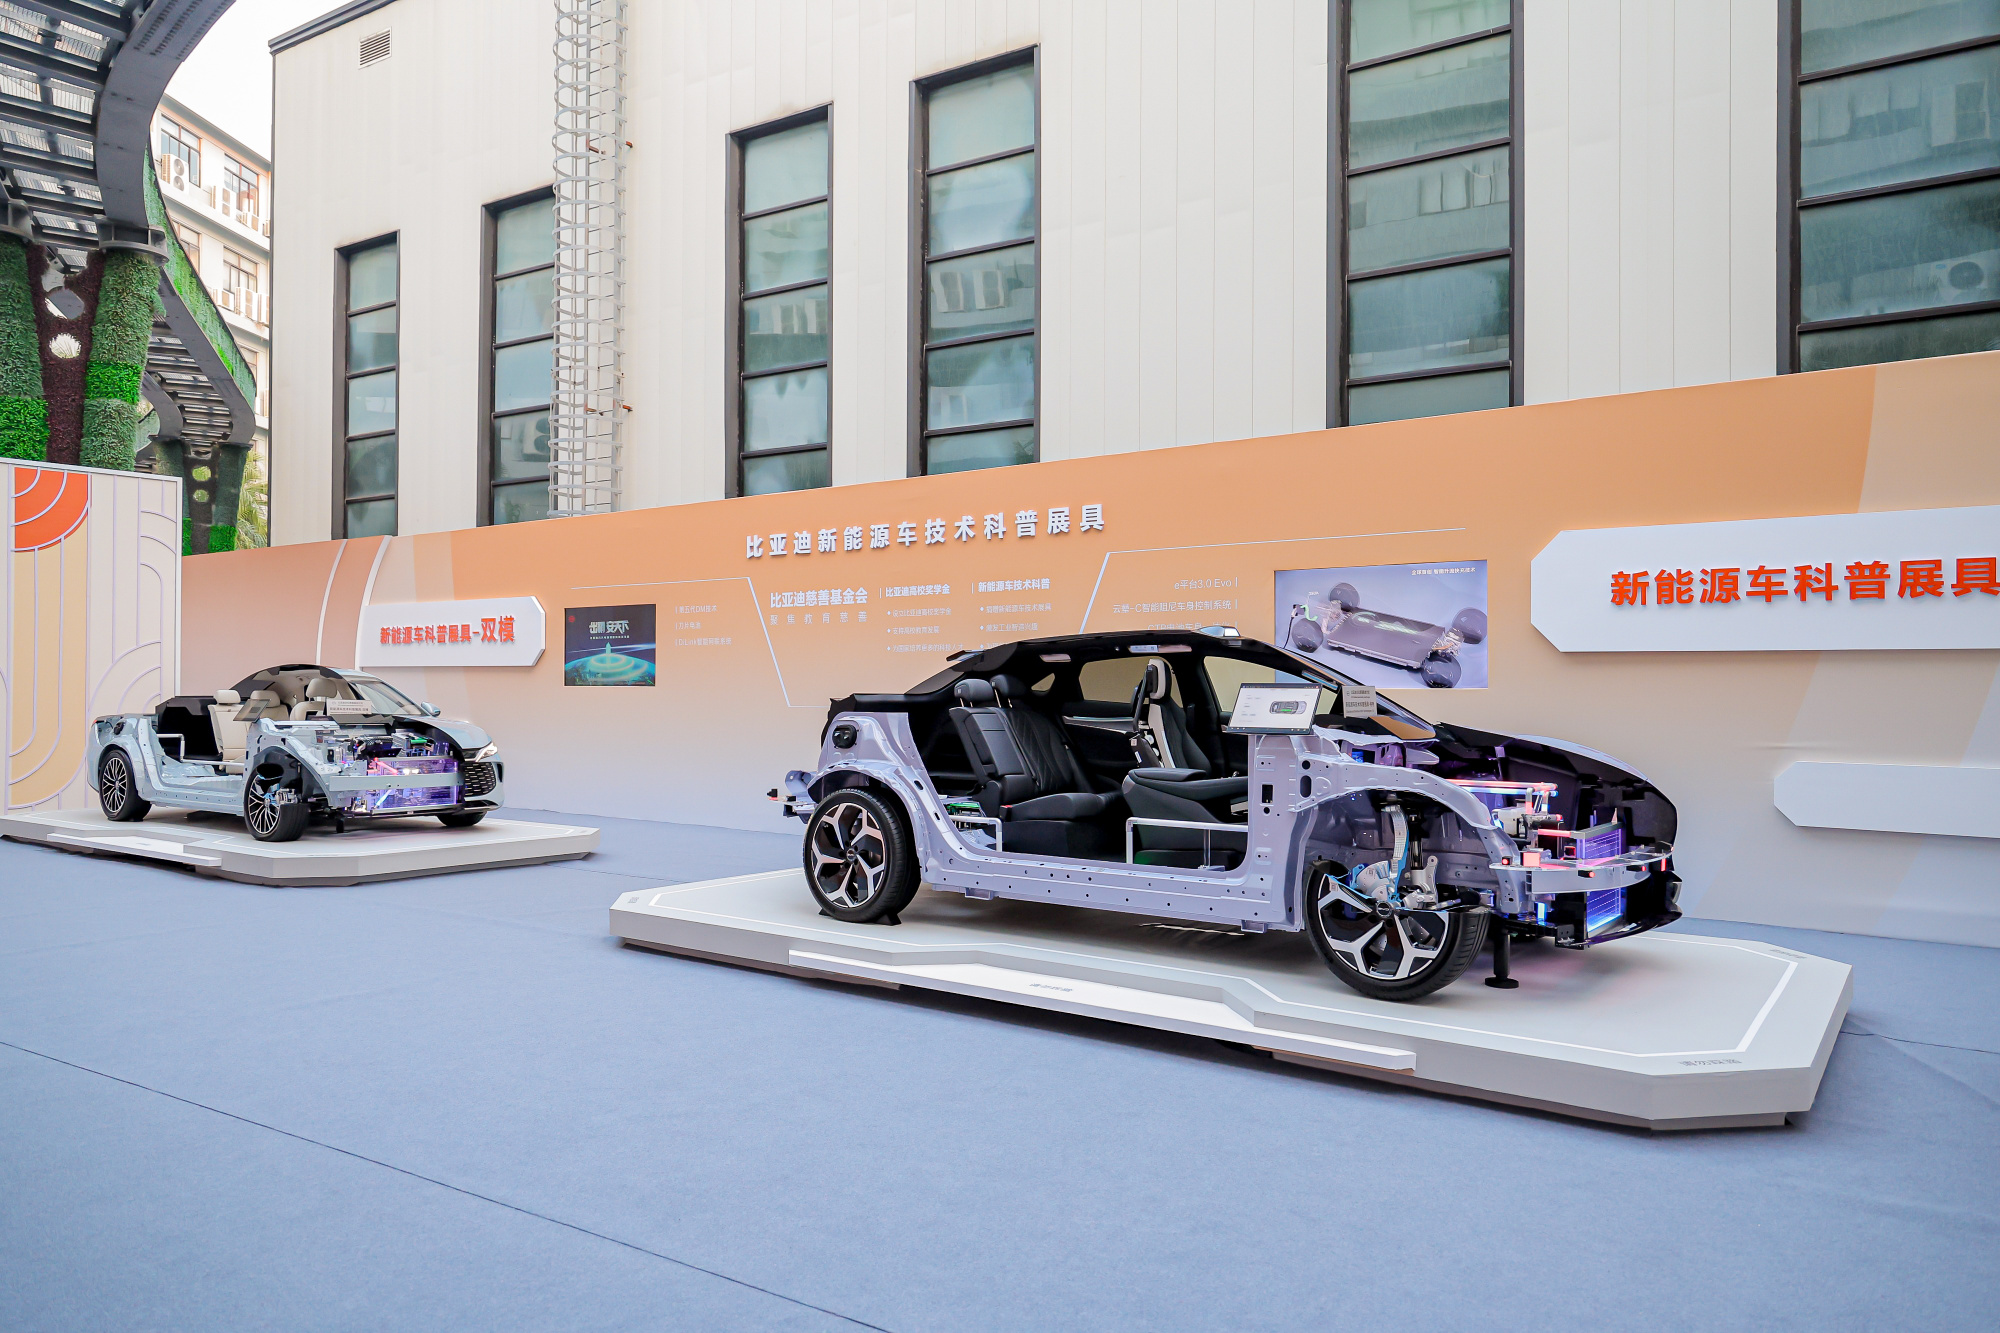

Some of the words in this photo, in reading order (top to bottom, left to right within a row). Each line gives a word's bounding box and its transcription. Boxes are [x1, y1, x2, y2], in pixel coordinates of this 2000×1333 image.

[746, 504, 1105, 559] 比亚迪新能源车技术科普展具
[885, 583, 951, 598] 比亚迪高校奖学金
[978, 578, 1051, 593] 新能源车技术科普
[1174, 579, 1212, 590] e平台3.0
[1214, 578, 1232, 588] Evo
[1610, 556, 2000, 606] 新能源车科普展具
[769, 587, 868, 609] 比亚迪慈善基金会
[770, 610, 868, 626] 聚焦教育慈善
[380, 615, 515, 645] 新能源车科普展具-双模
